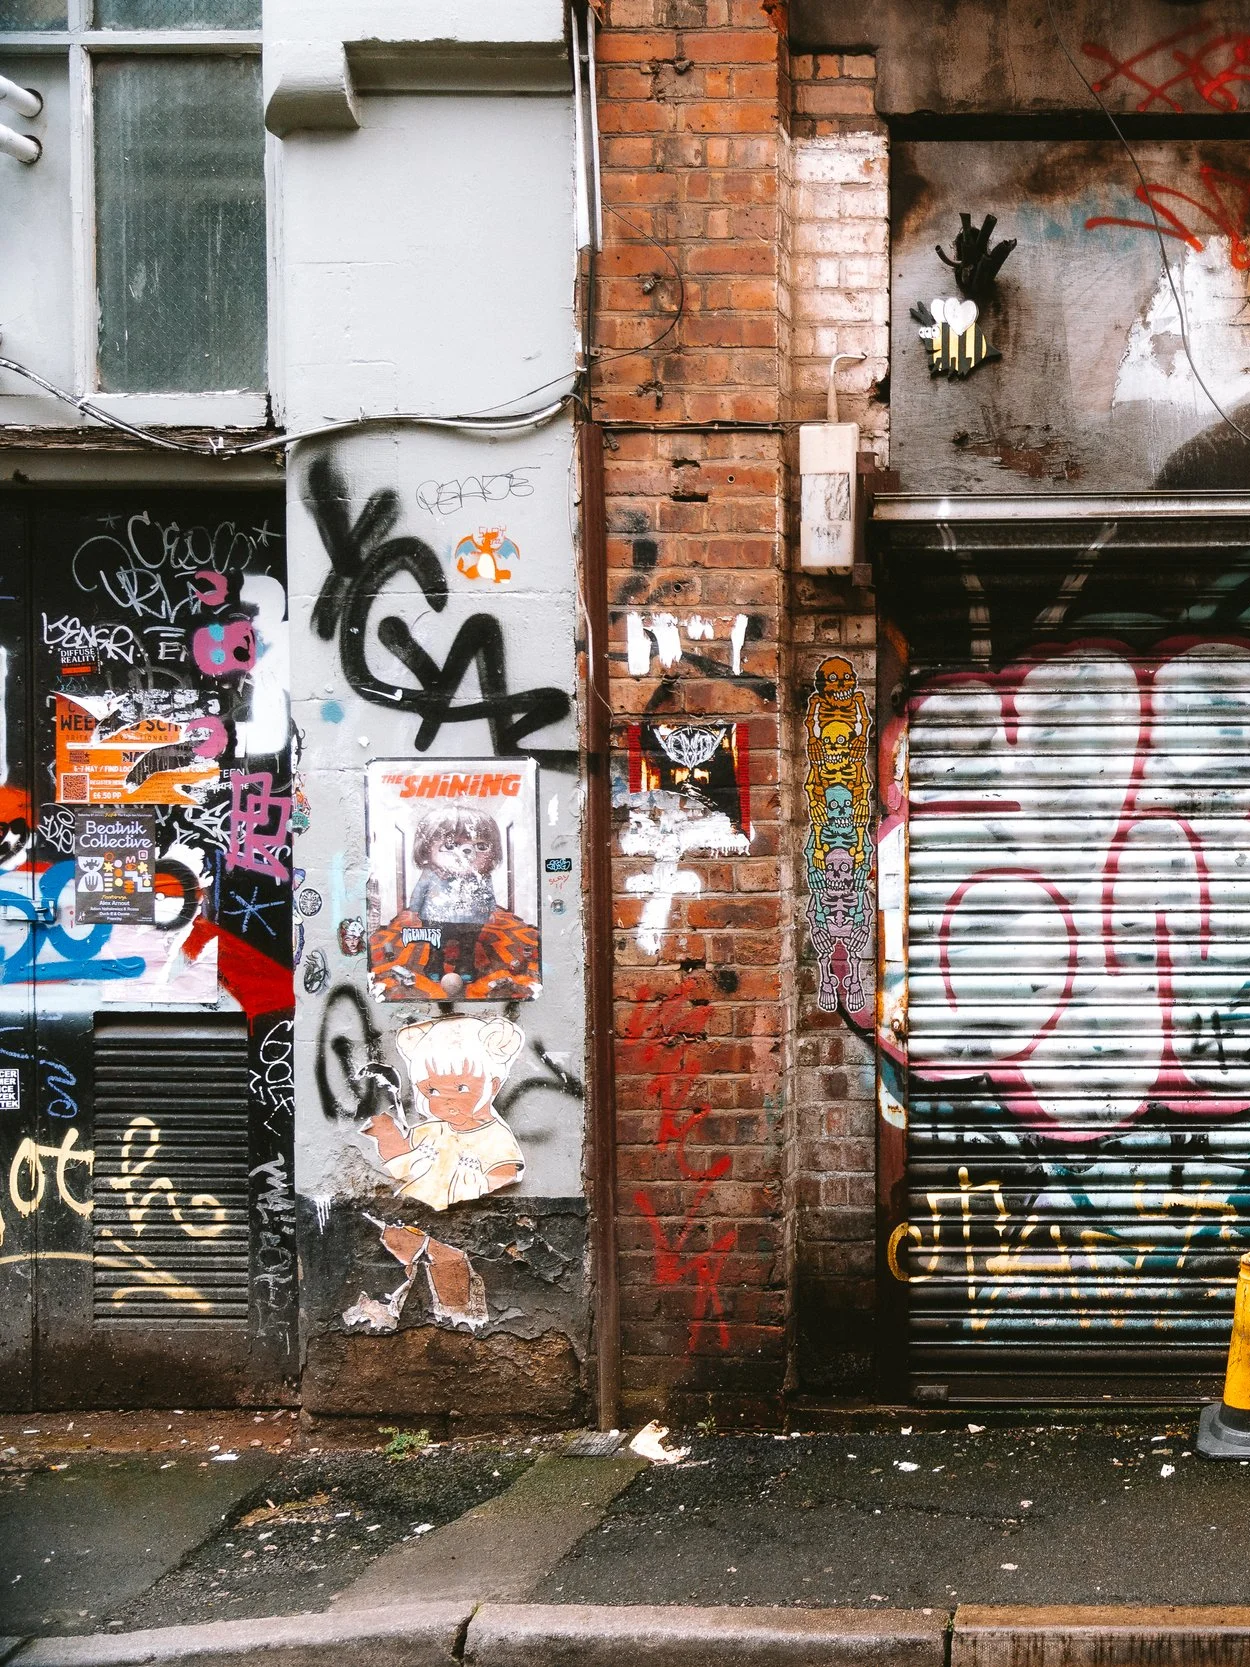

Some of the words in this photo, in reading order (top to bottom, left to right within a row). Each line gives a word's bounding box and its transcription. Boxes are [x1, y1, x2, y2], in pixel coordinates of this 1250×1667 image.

[60, 647, 96, 658] DIFFUSE
[61, 655, 97, 664] REALITY
[381, 775, 403, 785] THE
[85, 820, 147, 835] Beatnik
[79, 834, 153, 849] Collective
